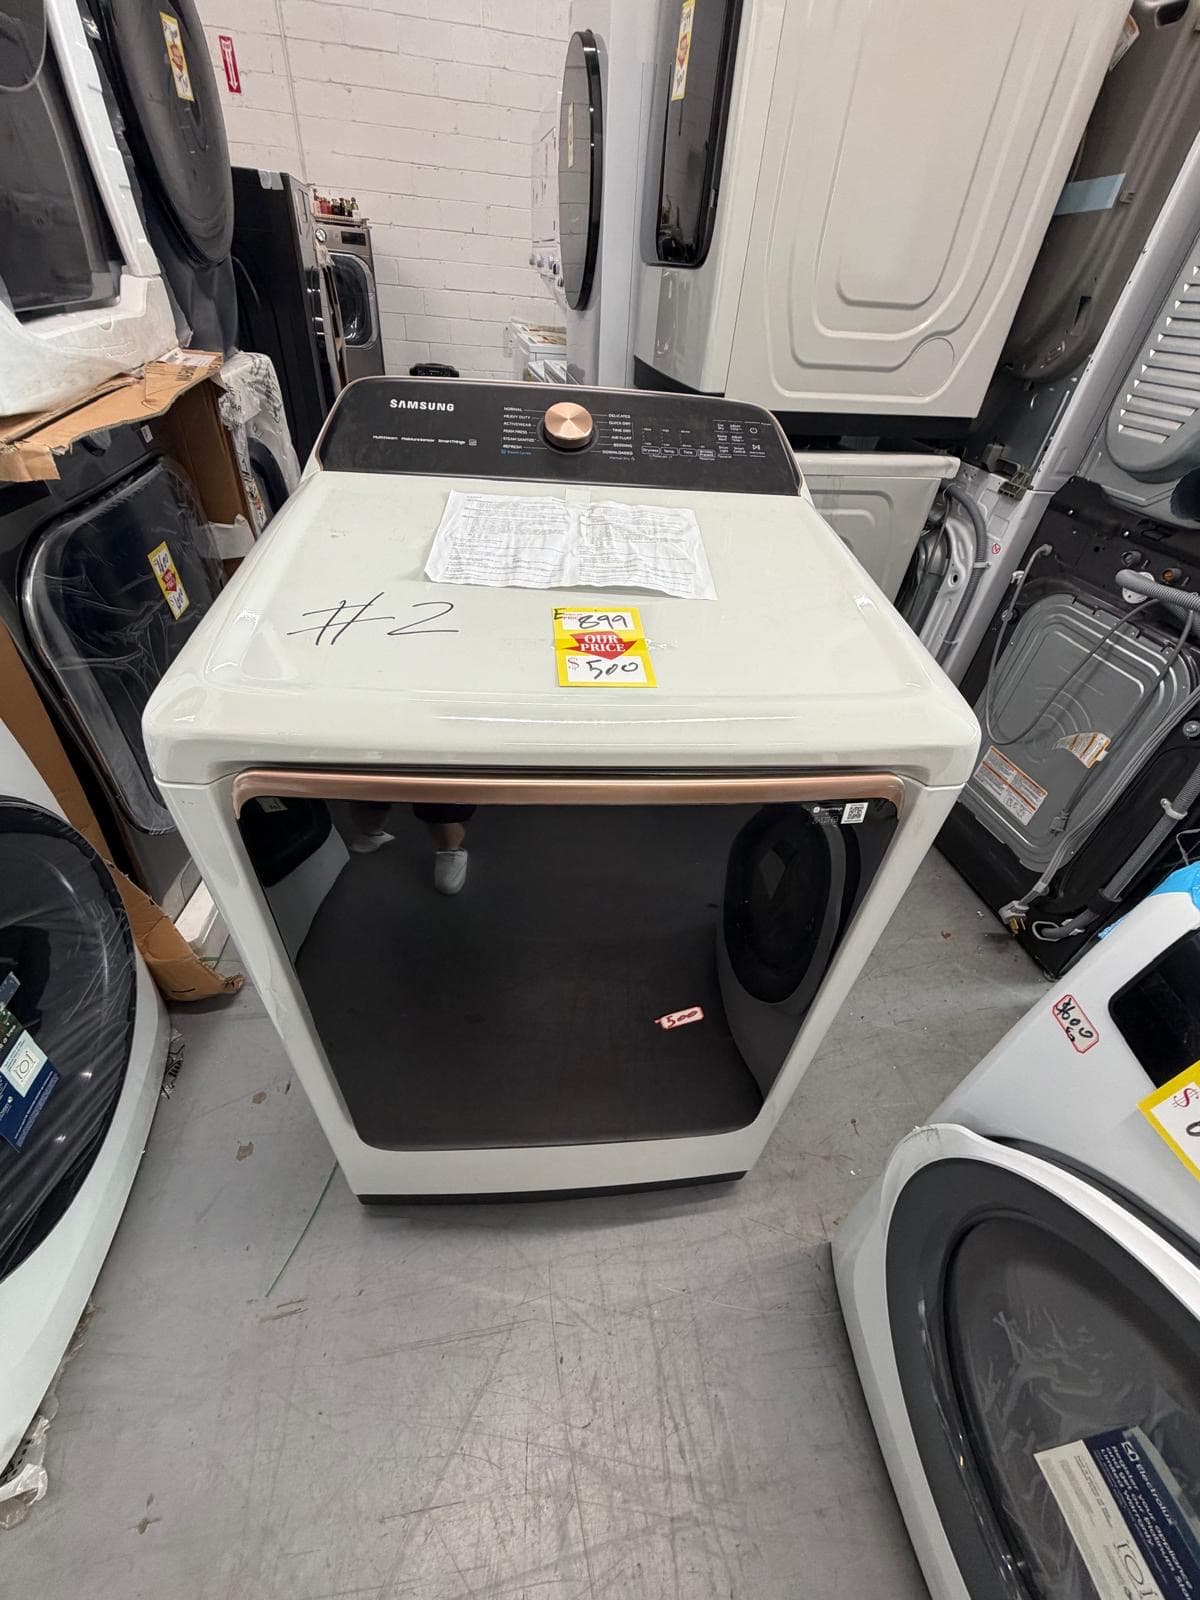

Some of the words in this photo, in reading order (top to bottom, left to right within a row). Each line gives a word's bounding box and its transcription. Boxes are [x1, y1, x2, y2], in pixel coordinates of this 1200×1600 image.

[390, 399, 455, 412] SAMSUNG
[287, 592, 460, 645] #2
[578, 614, 628, 630] 899
[580, 643, 626, 652] PRICE
[584, 634, 619, 644] OUR
[586, 659, 639, 680] 500
[666, 1010, 698, 1029] 500
[1106, 1447, 1121, 1469] and
[1119, 1472, 1133, 1490] get
[1131, 1493, 1145, 1513] our
[1136, 1463, 1174, 1526] Electrolux
[1111, 1446, 1139, 1491] Register
[1138, 1493, 1156, 1522] your
[1154, 1524, 1193, 1590] appliance
